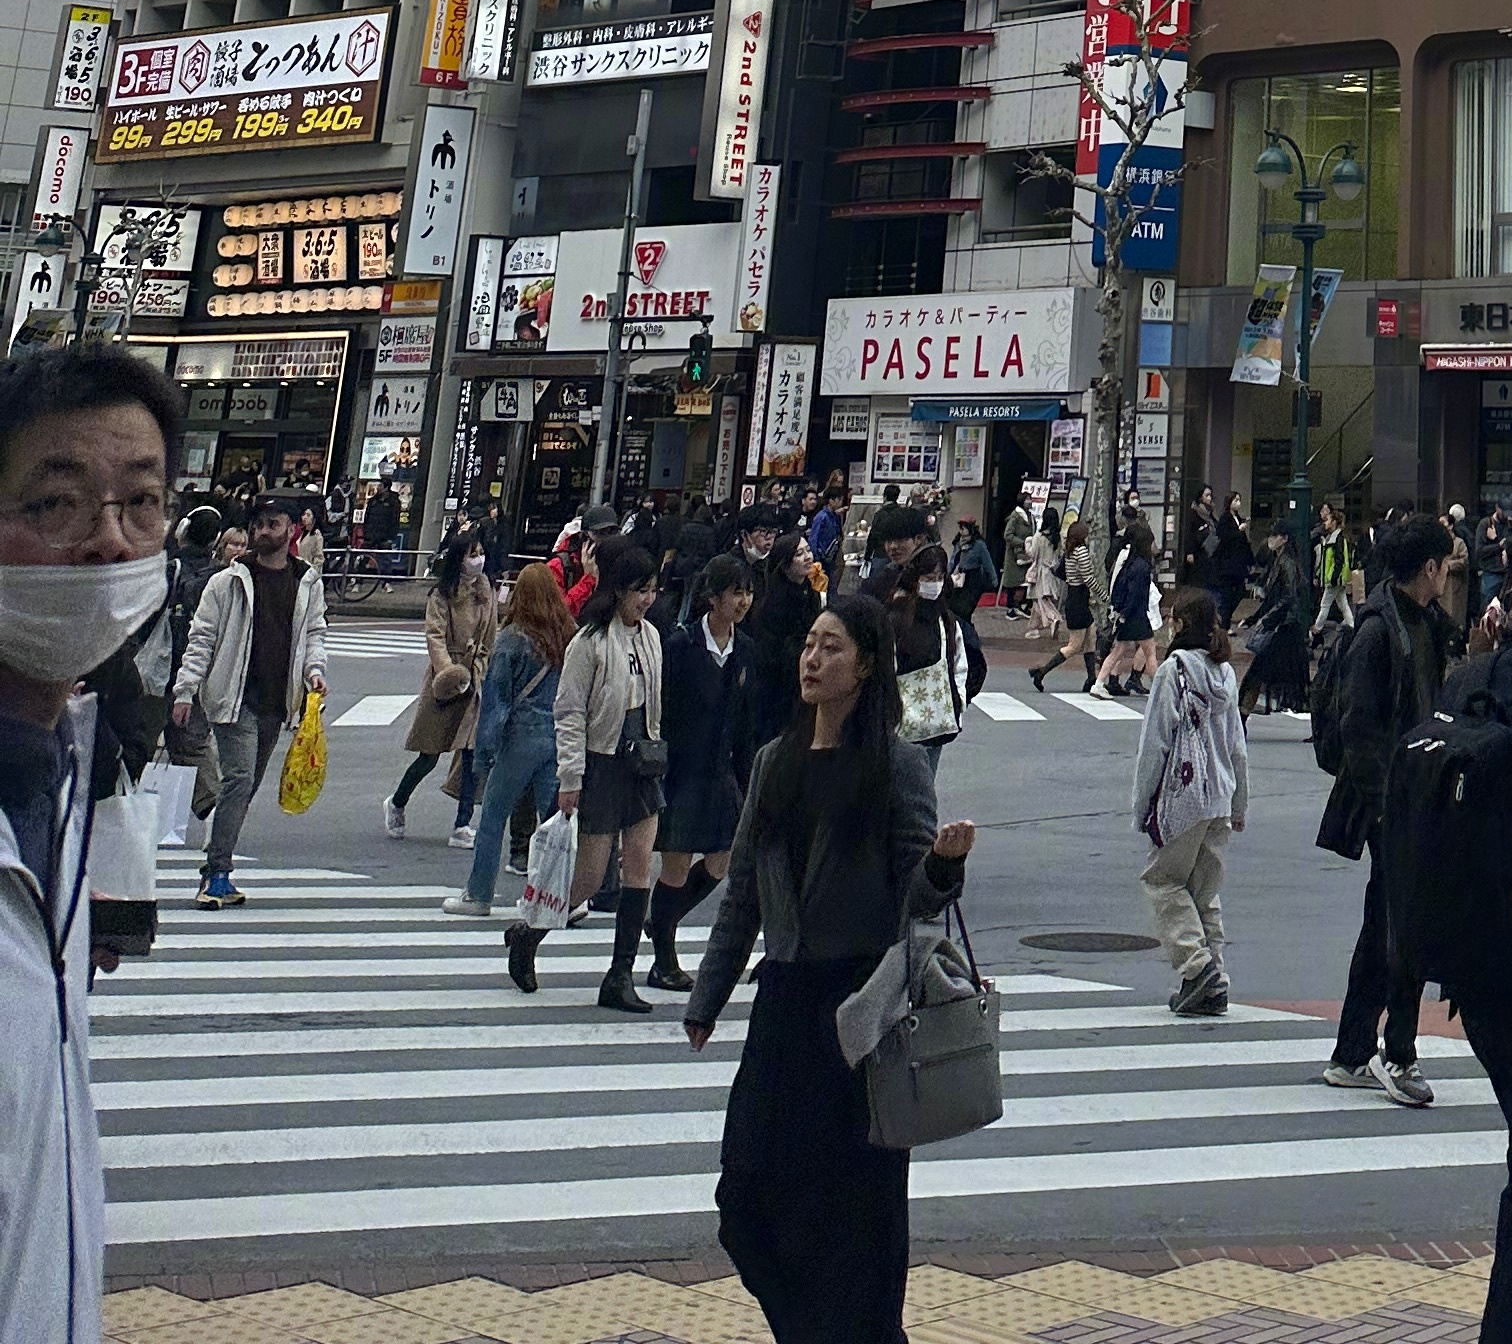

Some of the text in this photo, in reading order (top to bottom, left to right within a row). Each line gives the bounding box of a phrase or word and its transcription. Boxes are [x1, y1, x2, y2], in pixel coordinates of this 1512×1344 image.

[118, 50, 207, 95] 3F 肉
[435, 69, 454, 84] 6F
[532, 40, 710, 81] 渋谷サンクスクリニック
[108, 123, 153, 151] 99円
[160, 117, 224, 146] 299円
[296, 104, 364, 134] 340円
[112, 107, 157, 125] ハイボール
[165, 103, 228, 121] 生ビール・サワー
[730, 41, 757, 188] 2nd STREET
[49, 134, 75, 205] docomo
[421, 178, 442, 240] トリノ
[747, 167, 771, 299] カラオケ パセラ
[1131, 222, 1164, 240] ATM
[431, 254, 447, 267] B1
[626, 289, 712, 317] STREET
[864, 305, 1029, 330] カラオケ&パーティー
[378, 349, 393, 363] 5F
[859, 333, 1025, 381] PASELA
[772, 369, 792, 446] カラオケ
[948, 405, 1020, 418] PASELA RESORTS
